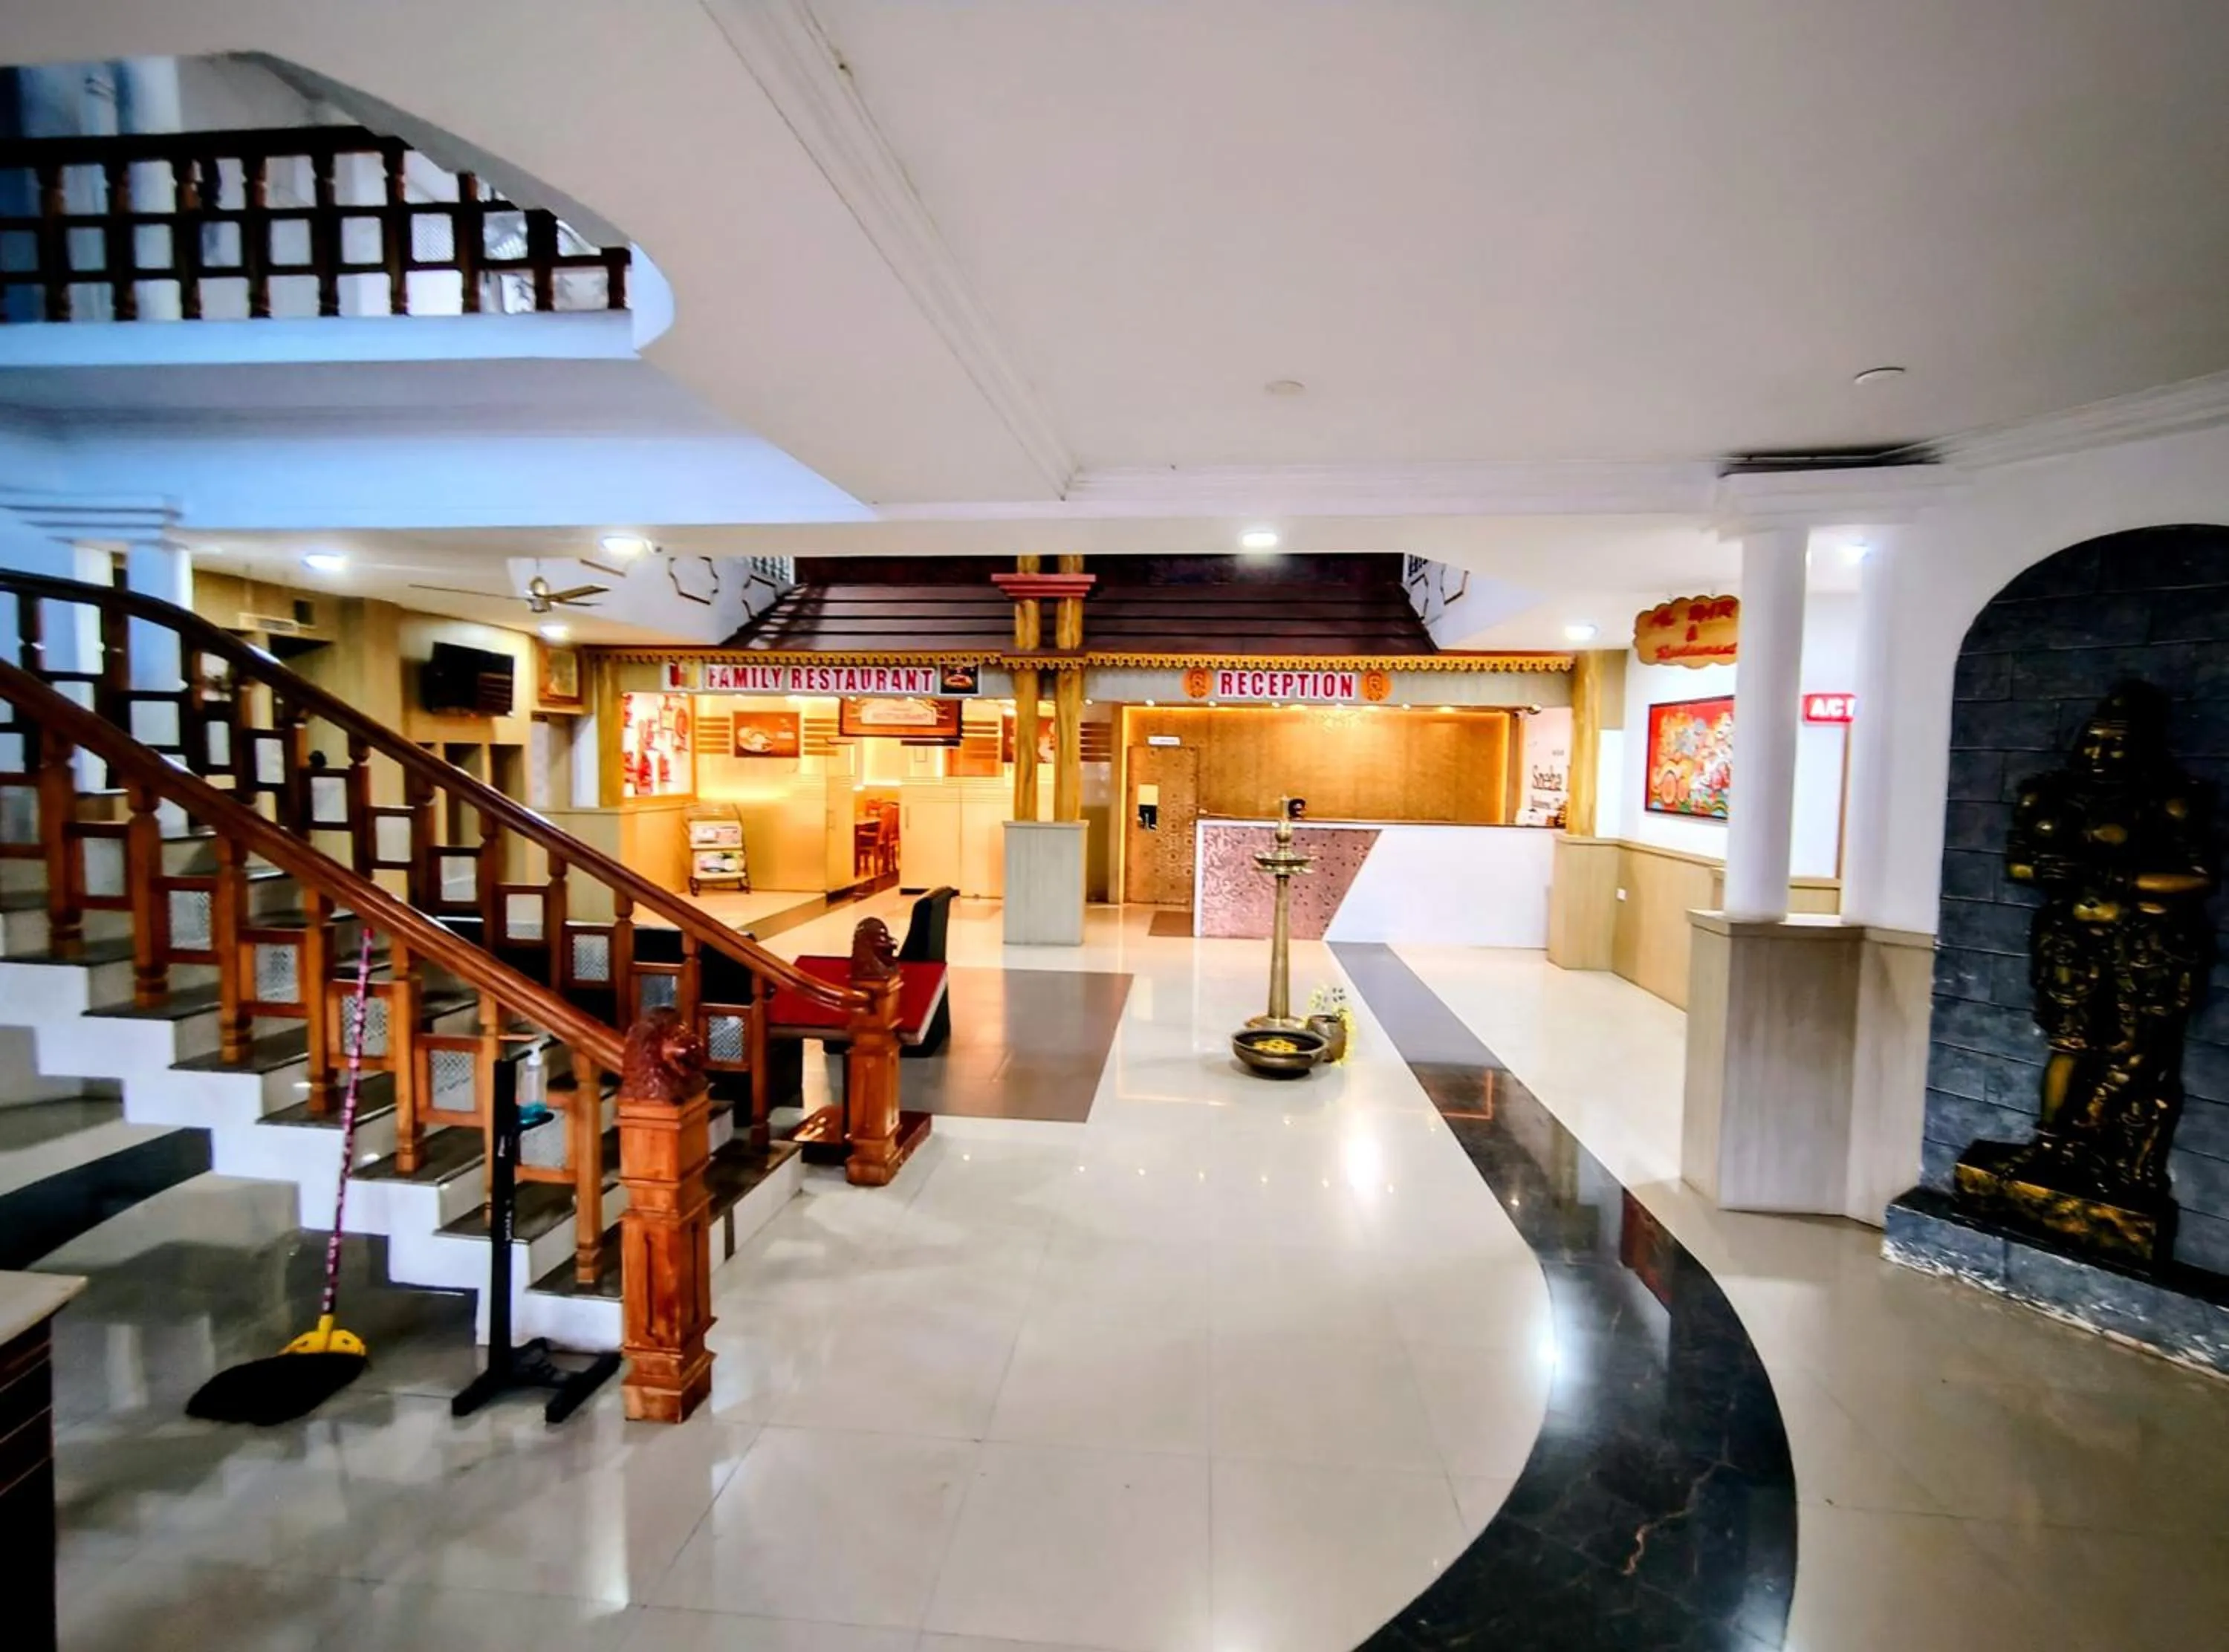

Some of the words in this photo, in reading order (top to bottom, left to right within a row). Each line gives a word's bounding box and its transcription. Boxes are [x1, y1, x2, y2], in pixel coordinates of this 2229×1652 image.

[708, 667, 782, 689] FAMILY
[791, 668, 933, 691] RESTAURANT
[1221, 672, 1353, 697] RECEPTION
